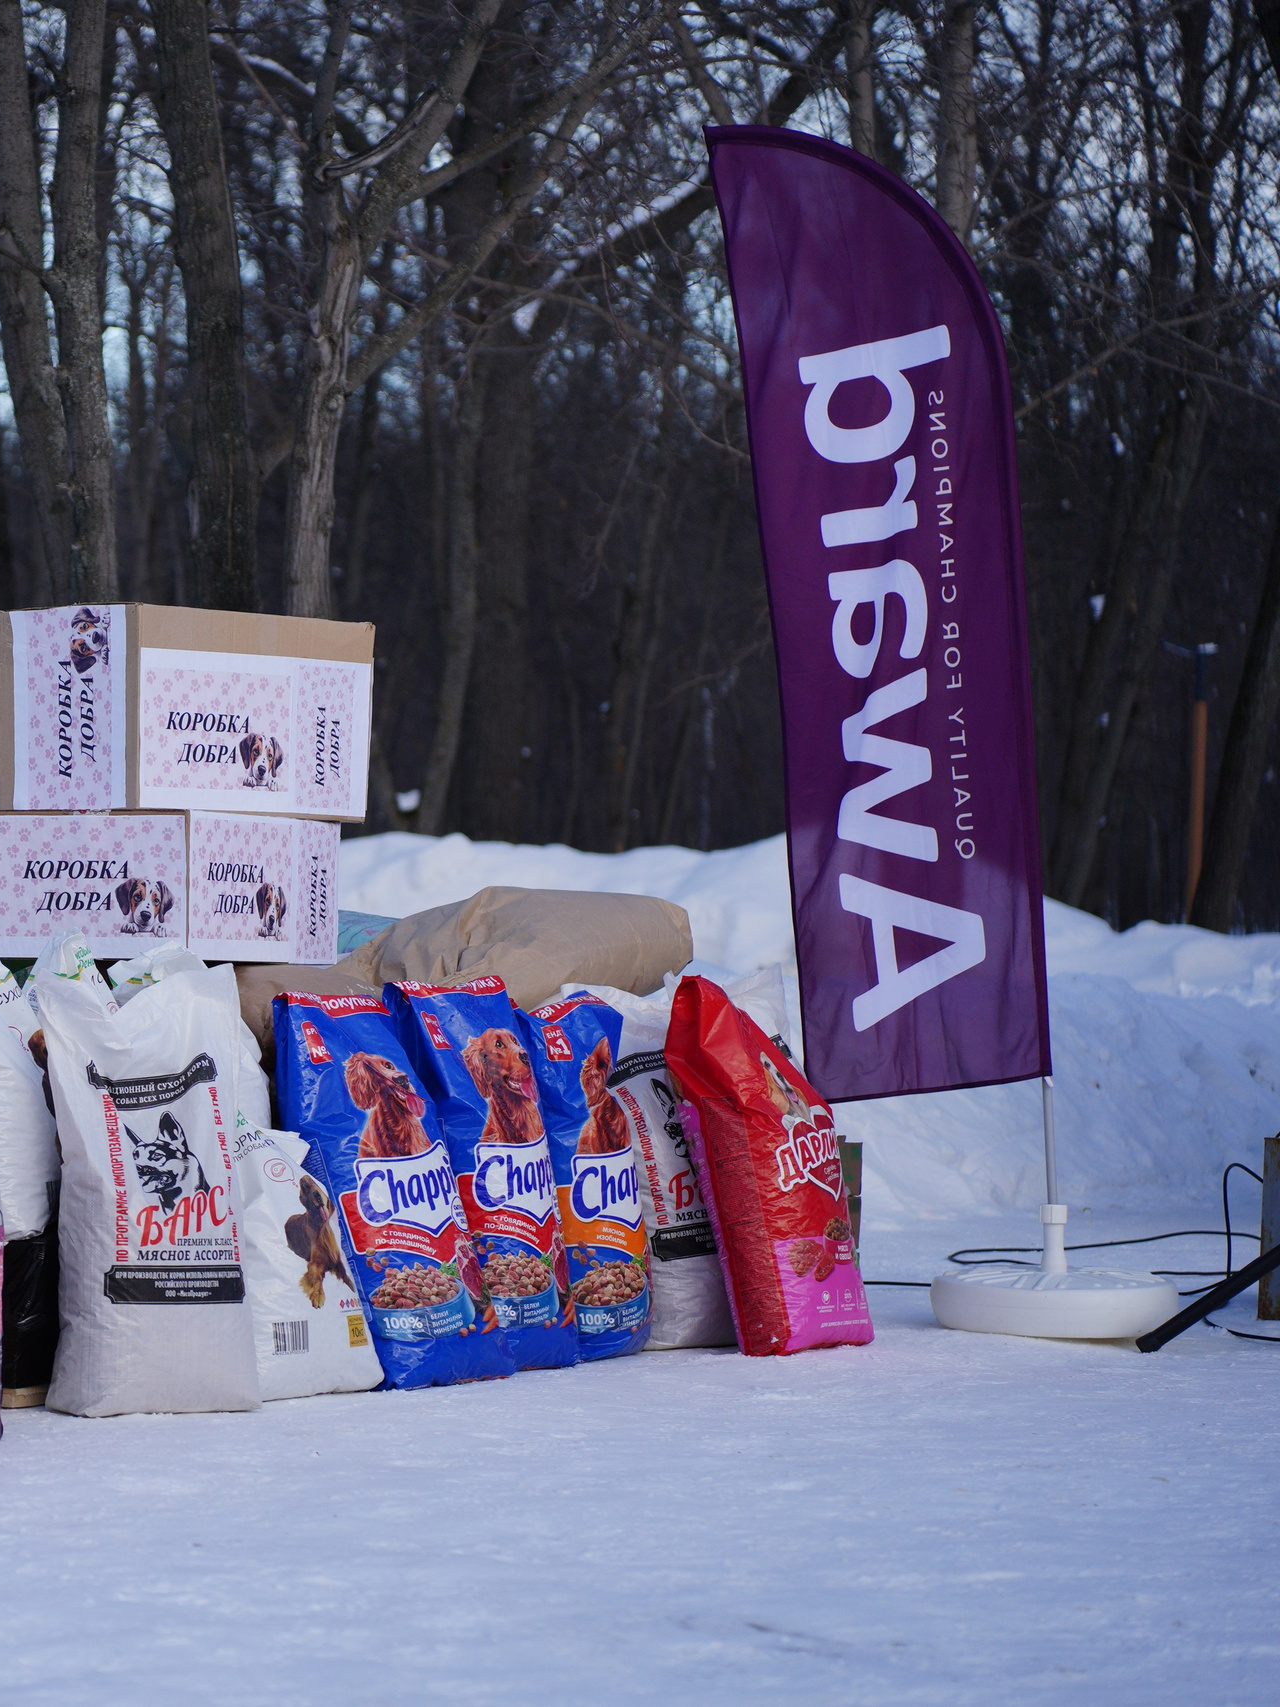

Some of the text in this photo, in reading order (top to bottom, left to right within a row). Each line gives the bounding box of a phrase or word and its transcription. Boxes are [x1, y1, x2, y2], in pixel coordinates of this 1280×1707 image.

[58, 660, 73, 779] КОРОБКА
[80, 676, 97, 762] ДОБРА
[166, 711, 252, 734] КОРОБКА
[177, 743, 237, 765] ДОБРА
[314, 706, 327, 787] КОРОБКА
[329, 720, 341, 778] ДОБРА
[22, 859, 129, 880] КОРОБКА
[207, 861, 264, 884] КОРОБКА
[36, 891, 112, 915] ДОБРА
[214, 893, 255, 916] ДОБРА
[309, 855, 319, 938] КОРОБКА
[319, 868, 328, 928] ДОБРА
[549, 1038, 570, 1055] №1
[157, 1060, 210, 1091] СУХОЙ КОРМ
[629, 1065, 644, 1074] ДЛЯ
[115, 1086, 185, 1105] СОБАК ВСЕХ ПОРОД
[208, 1086, 223, 1125] БЕЗ ГМО!
[217, 1132, 228, 1151] ГМО!
[234, 1130, 261, 1153] ОРМ
[222, 1153, 232, 1170] БЕЗ
[616, 1086, 669, 1226] ПО ПРОГРАММЕ ИМПОРТОЗАМЕЩЕНИЯ
[102, 1094, 129, 1262] ПО ПРОГРАММЕ ИМПОРТОЗАМЕЩЕНИЯ
[474, 1154, 552, 1210] Chapp
[359, 1156, 457, 1226] Chappi
[572, 1164, 638, 1219] Chap
[135, 1185, 228, 1247] БАРС
[499, 1215, 536, 1232] говядиной
[675, 1209, 708, 1223] МЯСН
[389, 1231, 430, 1244] говядиной
[484, 1223, 540, 1244] по-домашнему
[596, 1233, 628, 1247] изобилие
[602, 1227, 625, 1238] мясное
[177, 1238, 233, 1247] ПРЕМИУМ КЛАСС
[375, 1238, 437, 1255] по-домашнему
[137, 1249, 234, 1261] МЯСНОЕ АССОРТИ
[233, 1245, 241, 1262] БЕЗ
[127, 1271, 169, 1279] ПРОИЗВОДСТВЕ
[154, 1280, 188, 1288] РОССИЙСКОГО
[430, 1311, 449, 1320] БЕЛКИ
[523, 1302, 540, 1310] БЕЛКИ
[622, 1306, 638, 1315] БЕЛКИ
[383, 1316, 424, 1329] 100%
[432, 1313, 463, 1327] ВИТАМИНЫ
[433, 1321, 464, 1335] МИНЕРАЛЫ
[523, 1313, 549, 1324] МИНЕРАЛЫ
[579, 1312, 615, 1325] 100%
